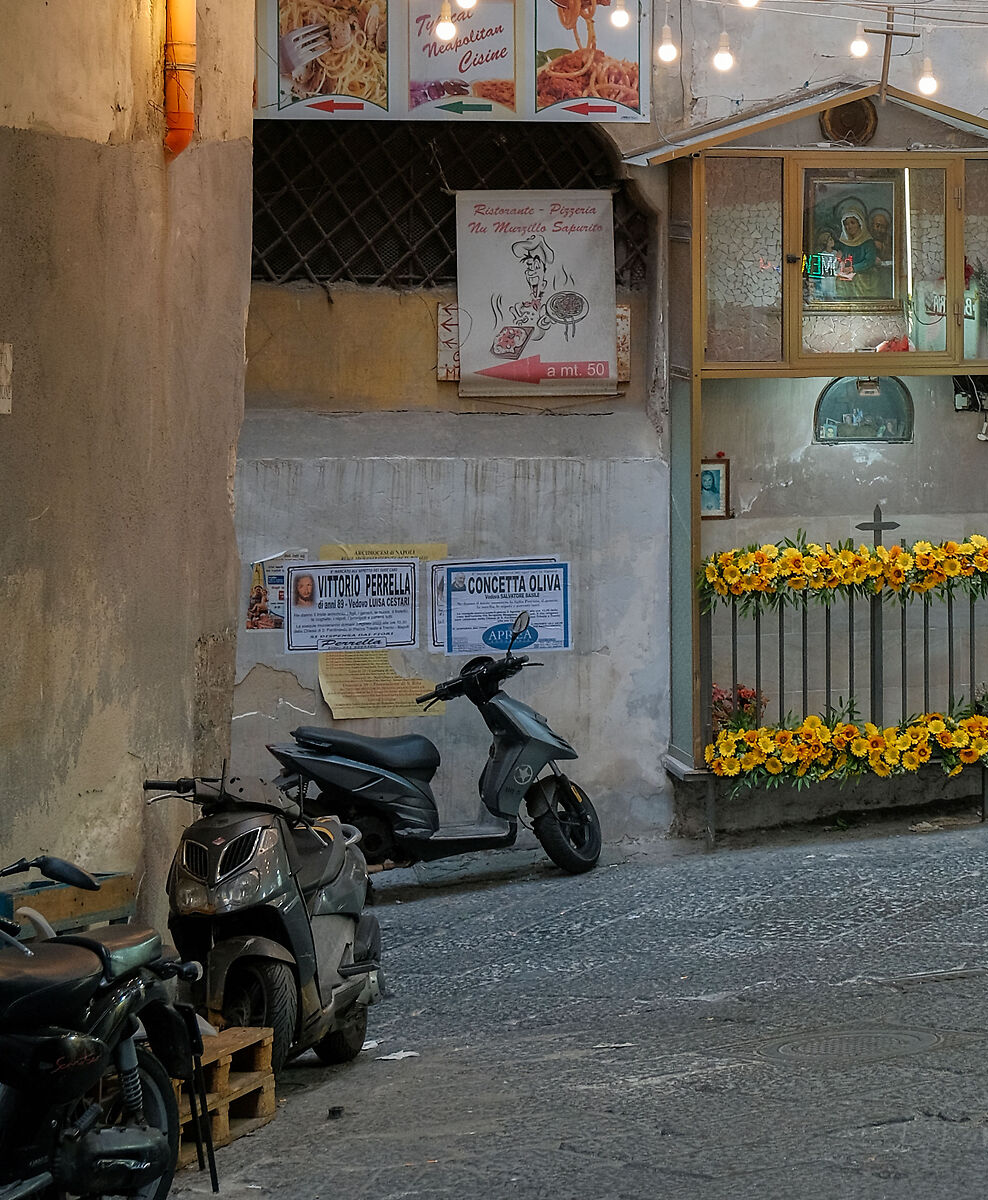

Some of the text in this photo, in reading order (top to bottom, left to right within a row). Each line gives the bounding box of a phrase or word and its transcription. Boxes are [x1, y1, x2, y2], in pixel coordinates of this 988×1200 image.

[422, 24, 505, 58] Neapolitan
[458, 47, 508, 73] Cisine
[473, 203, 535, 217] Ristorante
[549, 203, 598, 219] Pizzeria
[468, 221, 603, 236] Nu Murzillo Sapurito
[547, 363, 605, 377] a mt. 50
[318, 573, 411, 598] VITTORIO PERRELLA
[468, 574, 561, 594] CONCETTA OLIVA
[369, 598, 385, 607] LUISA
[387, 597, 410, 607] CESTARI
